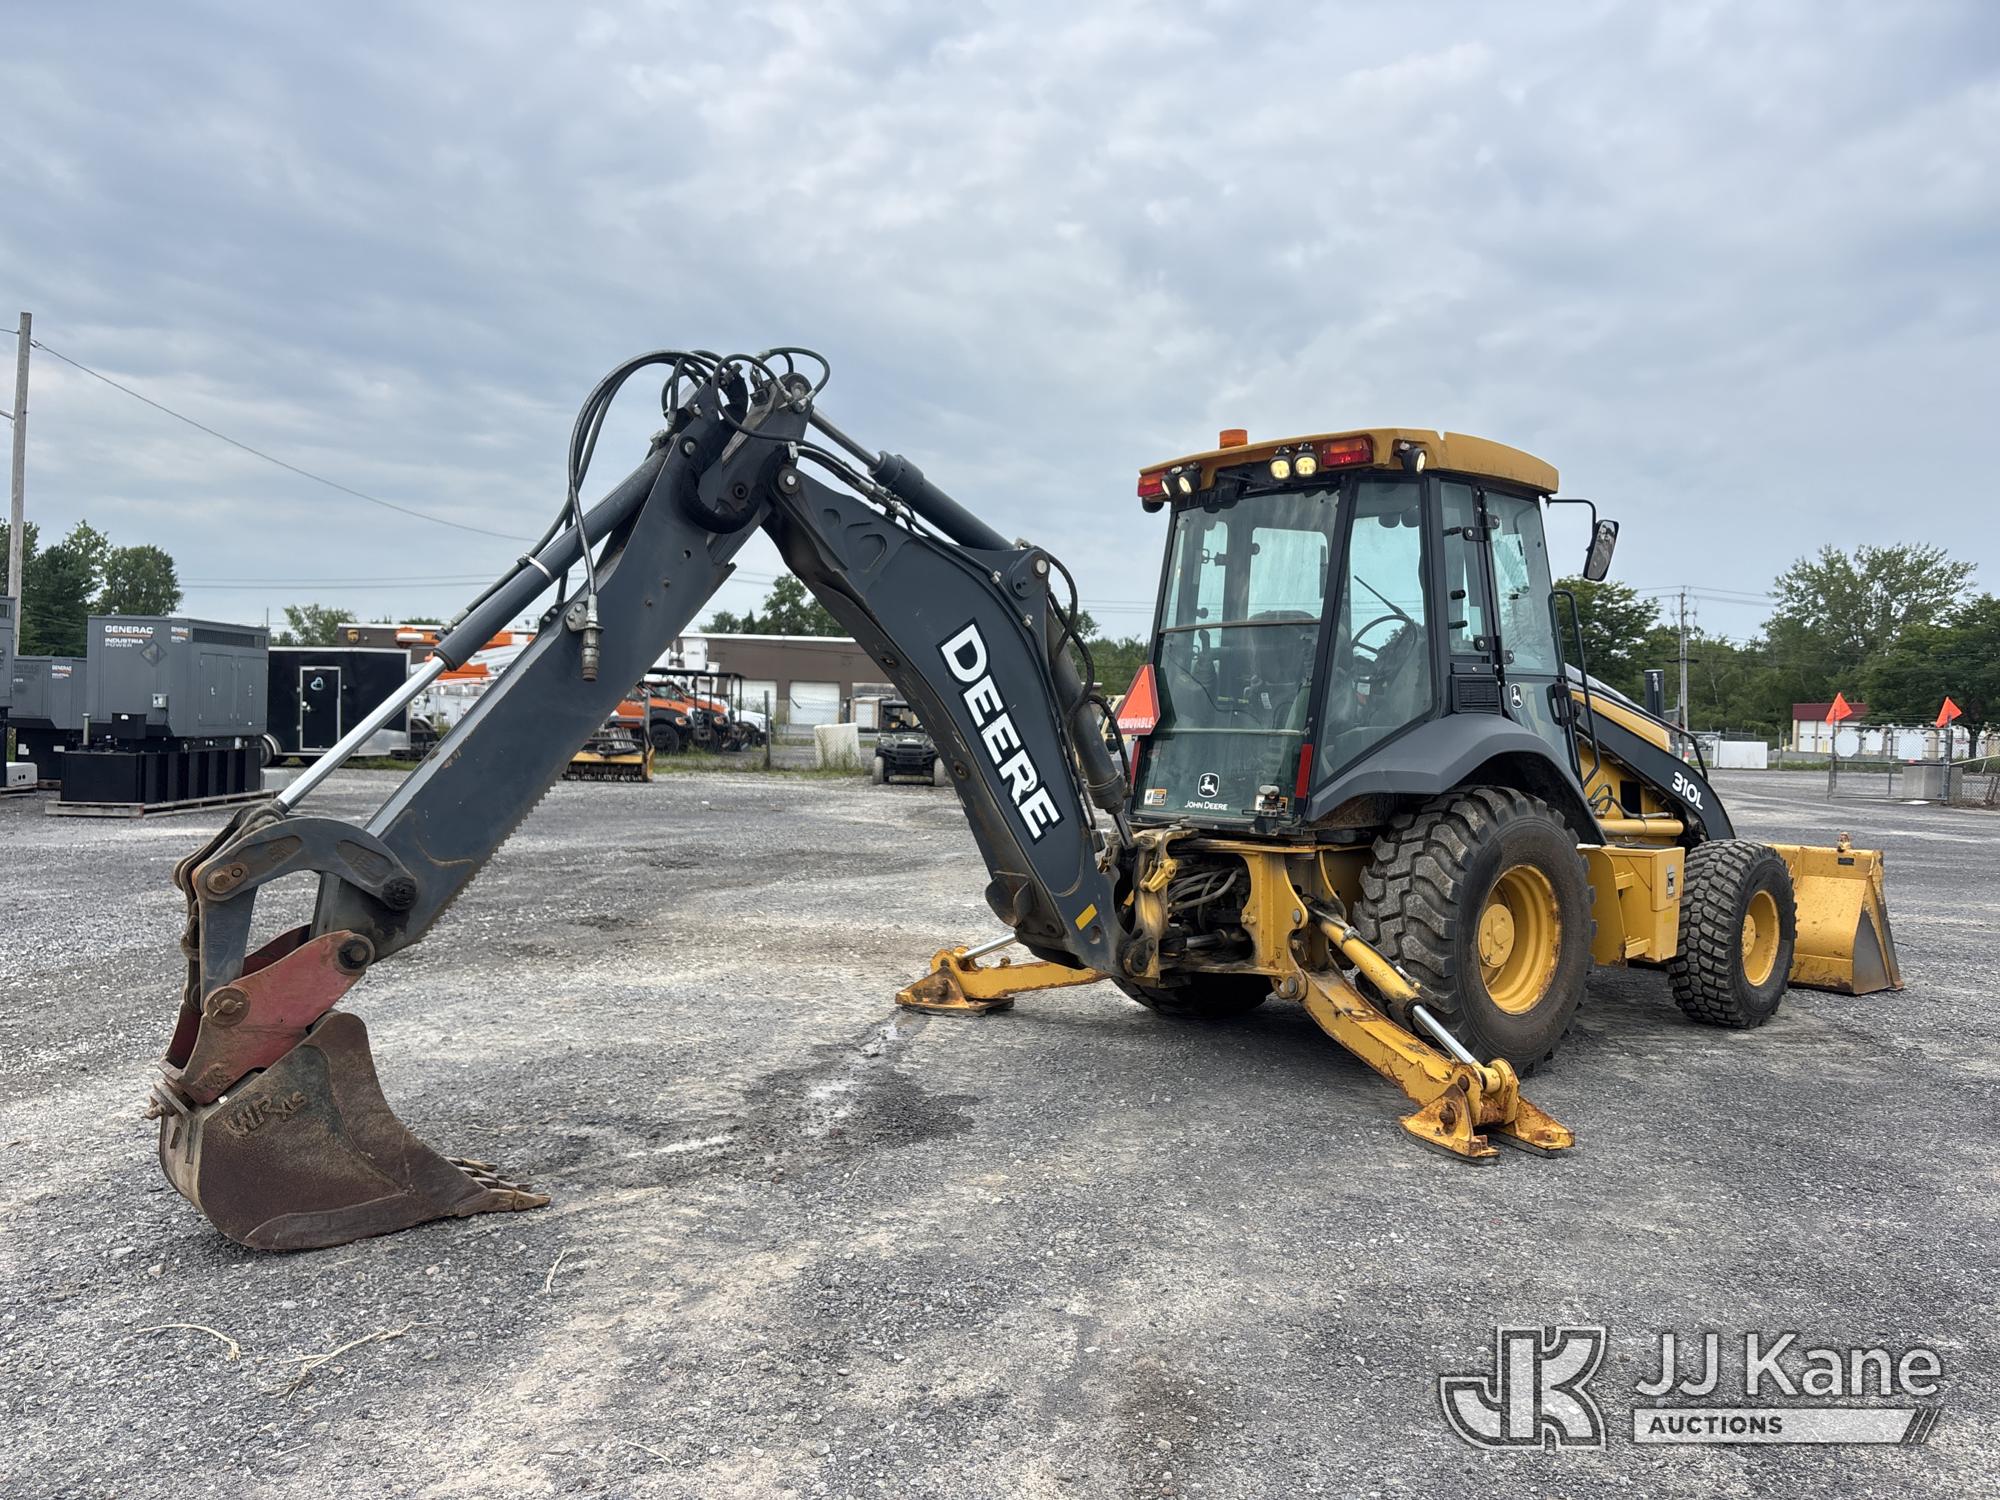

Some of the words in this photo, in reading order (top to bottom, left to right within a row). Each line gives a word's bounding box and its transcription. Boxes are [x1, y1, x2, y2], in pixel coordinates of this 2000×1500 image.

[105, 625, 155, 635] GENERAC
[941, 623, 1061, 840] DEERE
[1672, 771, 1704, 810] 310L
[1184, 800, 1203, 809] JOHN
[1204, 801, 1228, 811] DEERE
